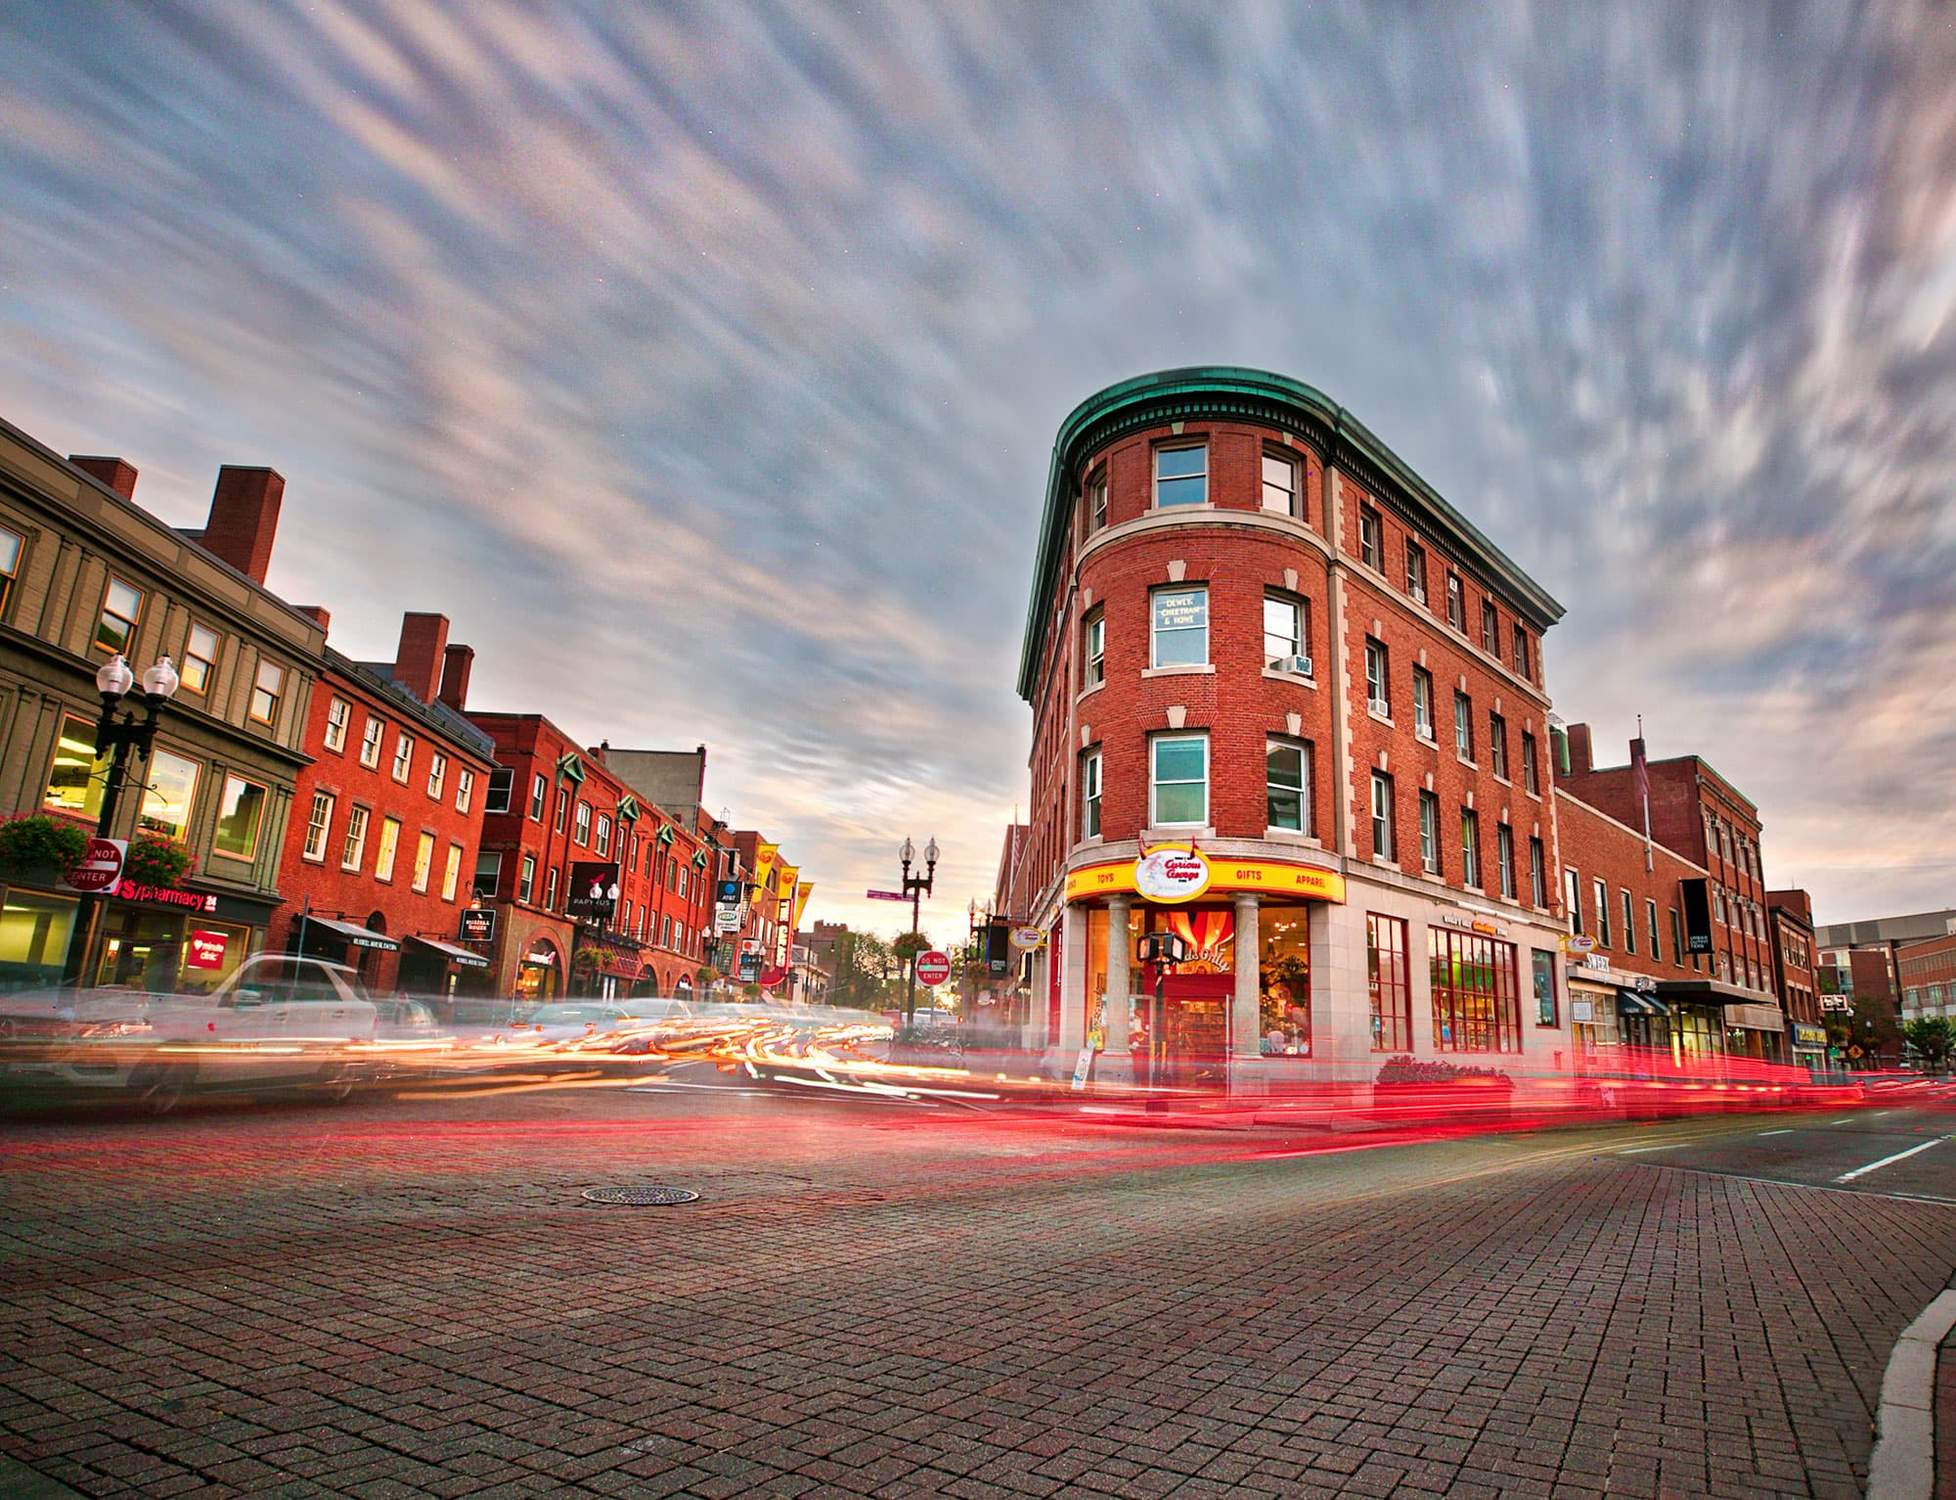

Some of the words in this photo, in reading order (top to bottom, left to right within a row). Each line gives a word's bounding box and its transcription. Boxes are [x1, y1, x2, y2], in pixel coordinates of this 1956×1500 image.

[94, 849, 116, 859] NOT
[1164, 859, 1201, 870] Curious
[1097, 873, 1115, 885] TOYS
[1166, 869, 1199, 881] George
[1236, 870, 1262, 881] GIFTS
[1296, 875, 1326, 888] APPAREL
[111, 877, 205, 912] S/pharmacy
